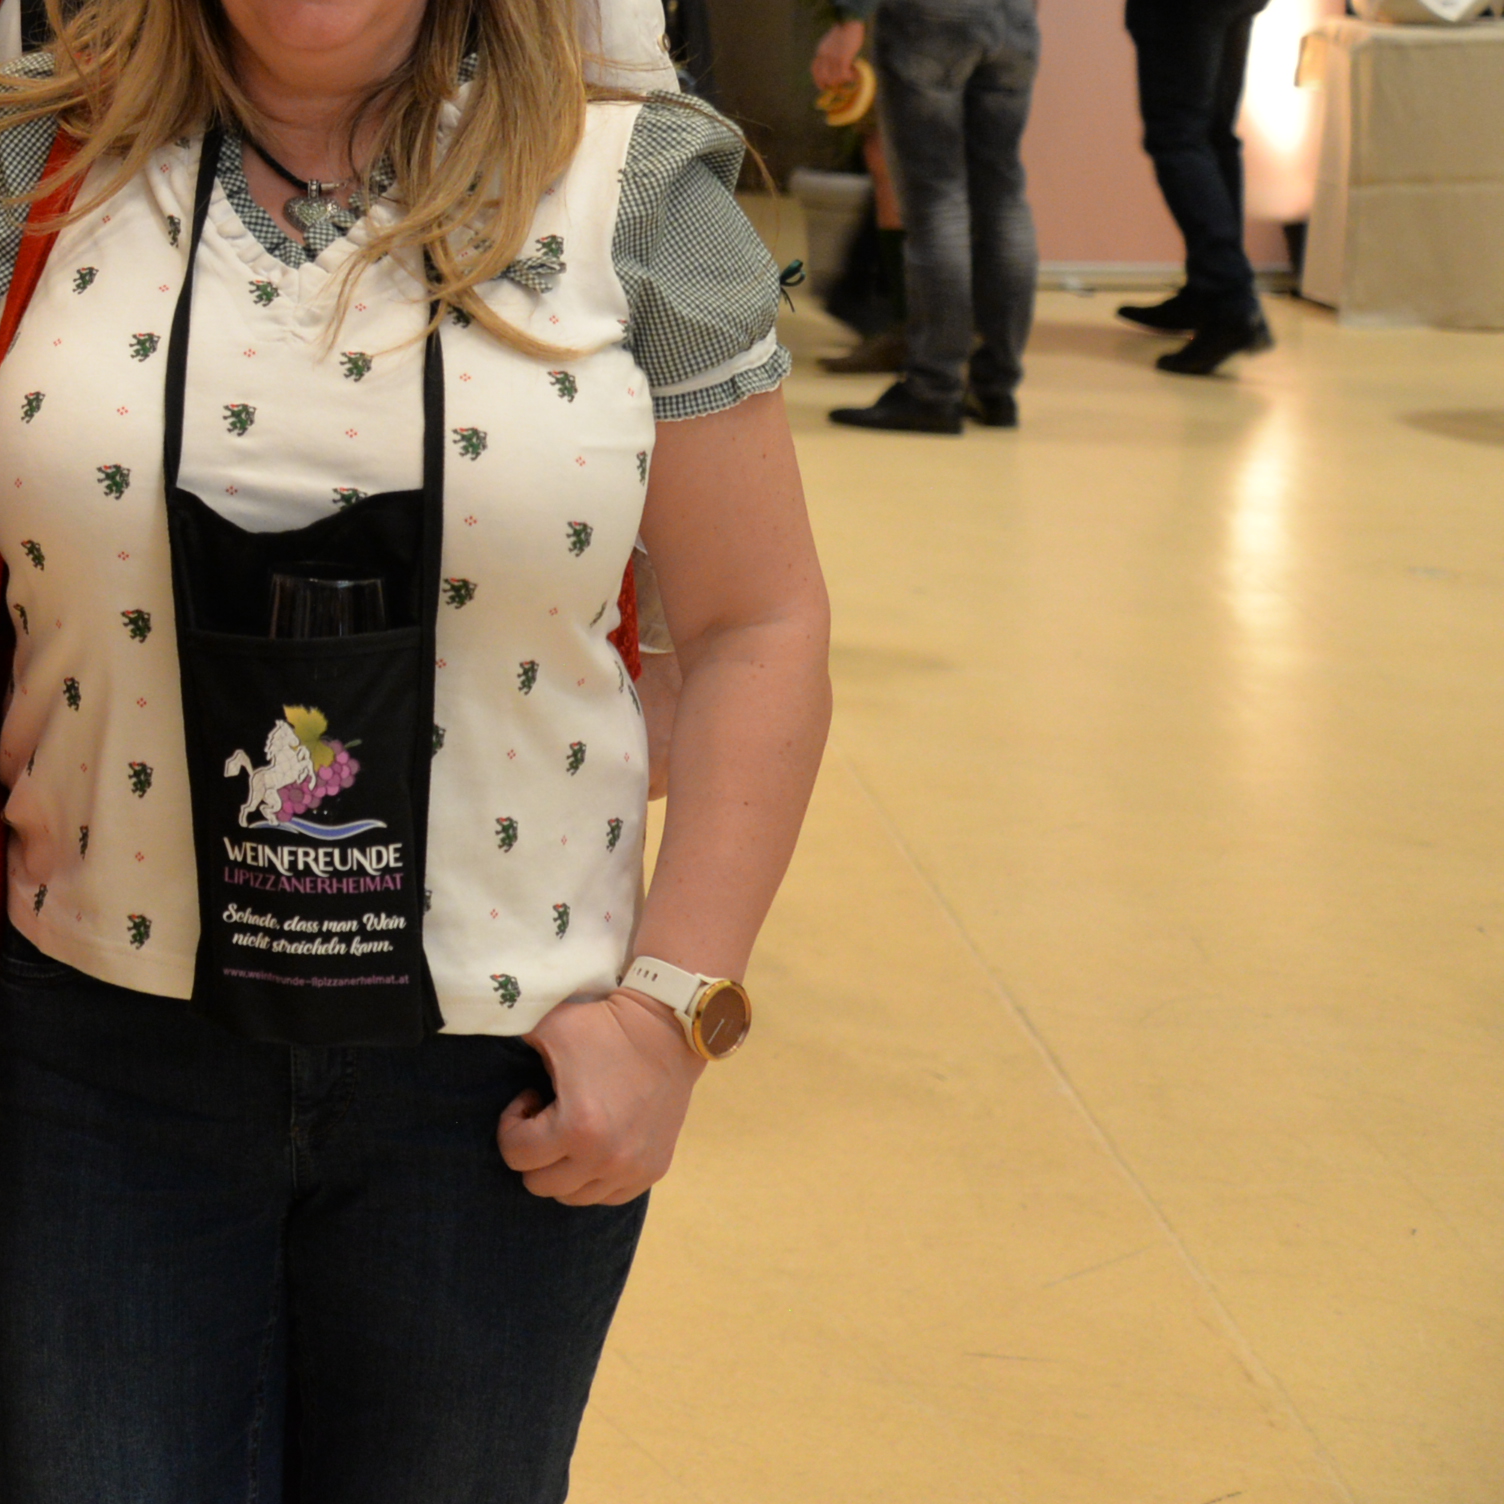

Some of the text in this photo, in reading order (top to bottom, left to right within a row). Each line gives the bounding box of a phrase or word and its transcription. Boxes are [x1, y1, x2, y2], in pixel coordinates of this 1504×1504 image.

[224, 837, 403, 877] WEINFREUNDE
[224, 867, 404, 895] LIPIZZANERHEIMAT
[222, 903, 406, 933] Schade, dass man Wein
[232, 931, 393, 957] nicht streicheln kann.
